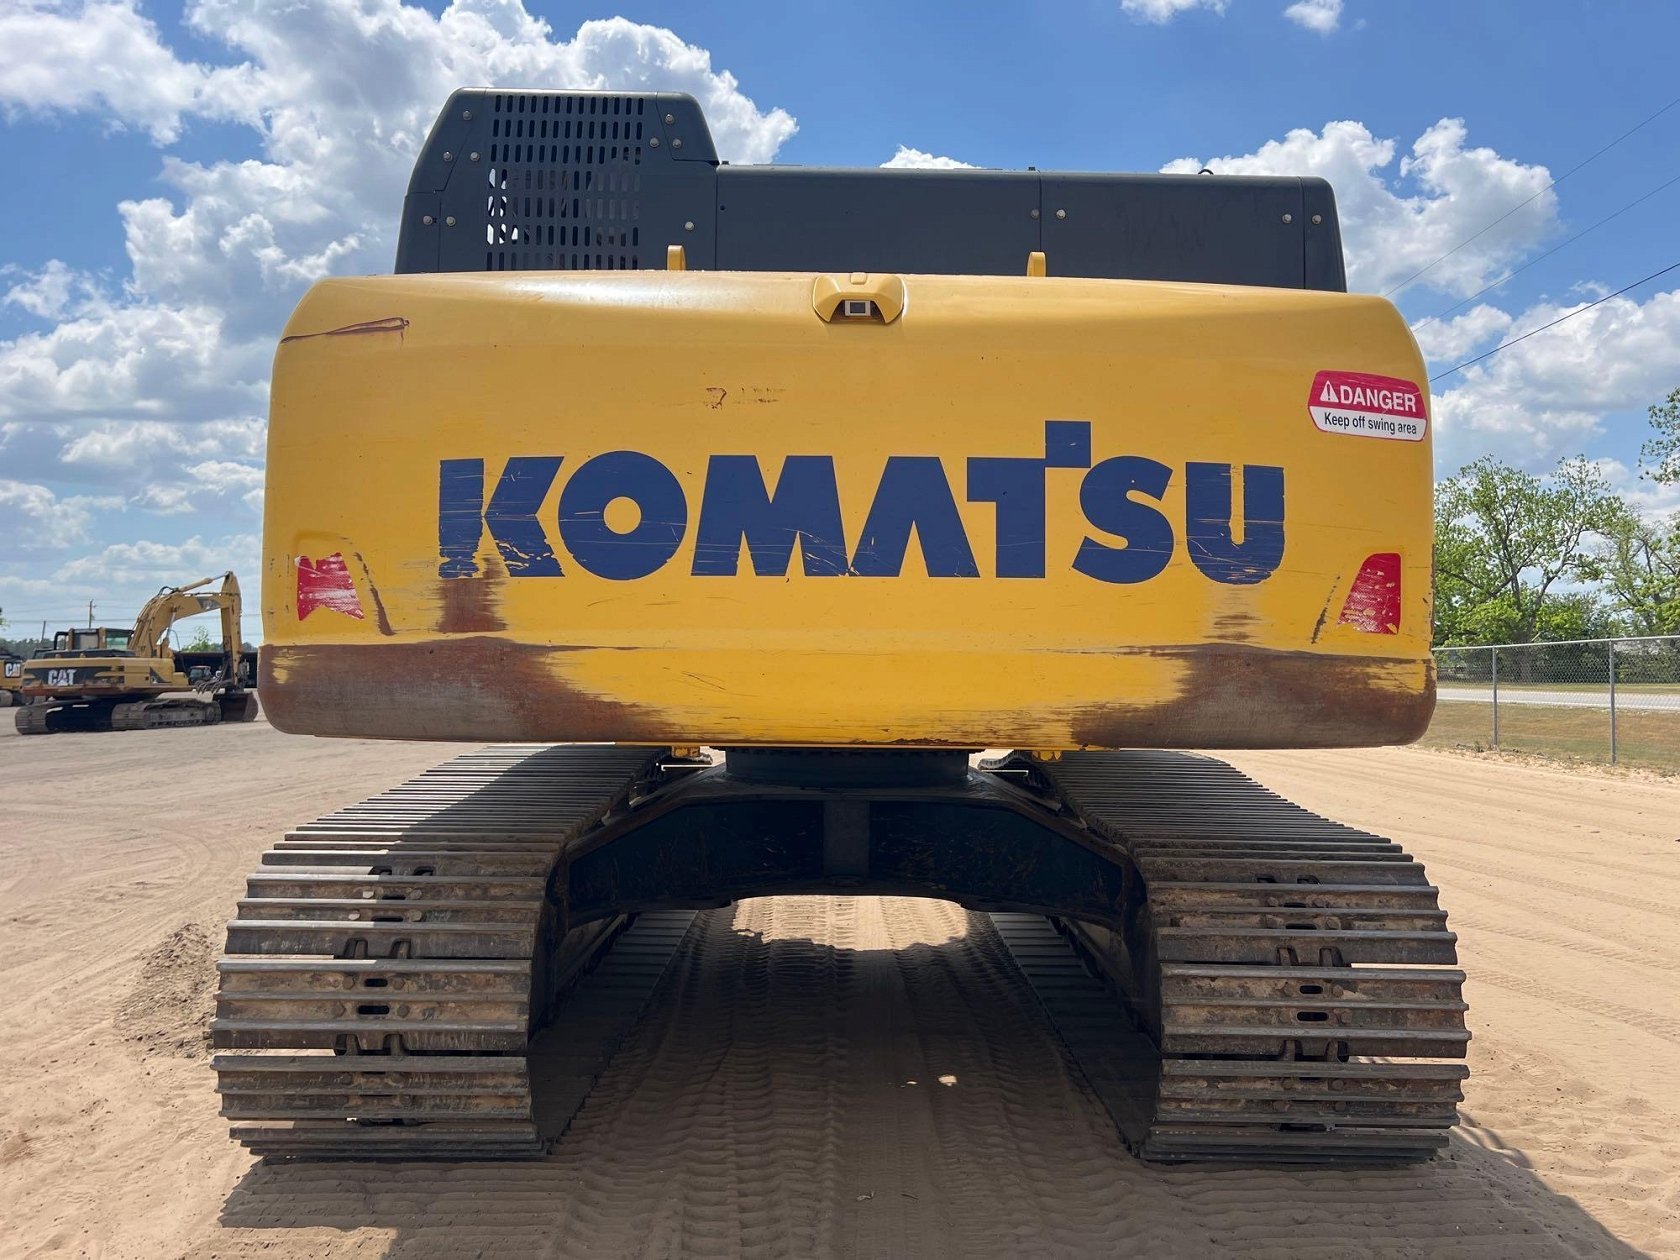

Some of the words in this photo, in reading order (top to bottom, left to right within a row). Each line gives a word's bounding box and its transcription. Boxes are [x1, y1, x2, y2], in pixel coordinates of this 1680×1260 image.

[1339, 385, 1416, 412] DANGER
[1324, 412, 1350, 429] Keep
[1352, 415, 1366, 428] off
[1368, 418, 1395, 435] swing
[1397, 422, 1417, 434] area
[439, 420, 1285, 585] KOMATSU
[5, 662, 21, 677] CAT
[47, 669, 77, 686] CAT
